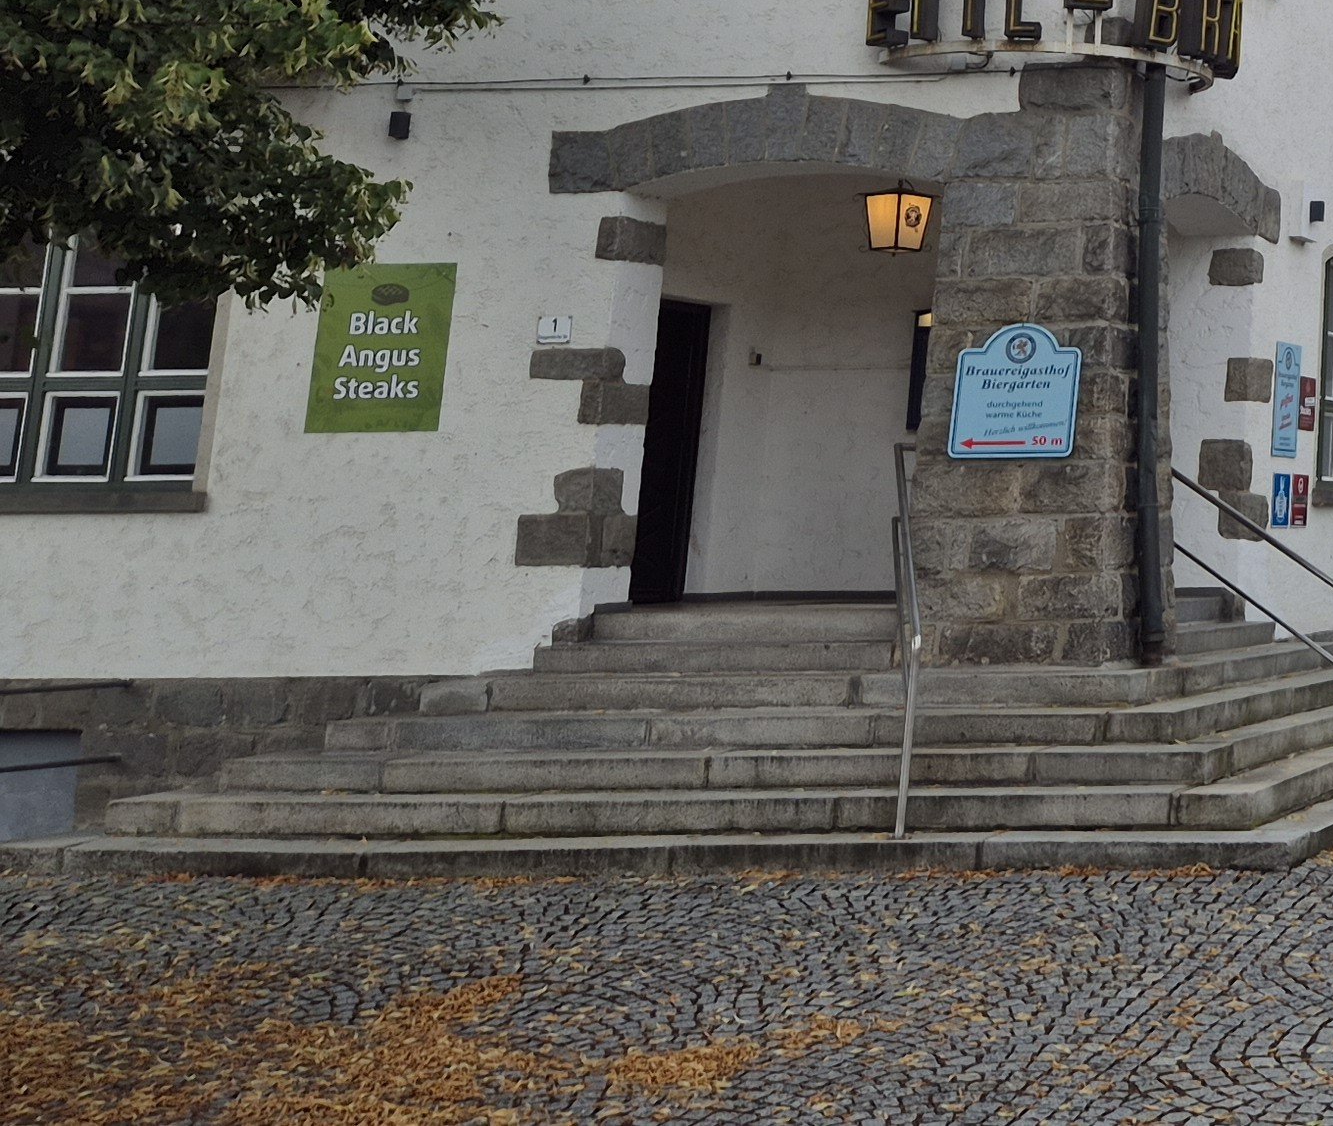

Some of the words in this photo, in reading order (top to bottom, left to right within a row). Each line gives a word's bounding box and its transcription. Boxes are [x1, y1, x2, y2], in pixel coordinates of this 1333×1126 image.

[348, 309, 419, 337] Black
[551, 317, 558, 333] 1
[338, 344, 421, 373] Angus
[965, 364, 1071, 378] Brauereigasthof
[332, 375, 419, 400] Steaks
[982, 379, 1050, 392] Biergarten
[986, 401, 1043, 409] durchgehend
[983, 426, 1016, 437] Herzlich
[1031, 435, 1047, 446] 50
[1050, 437, 1063, 446] m
